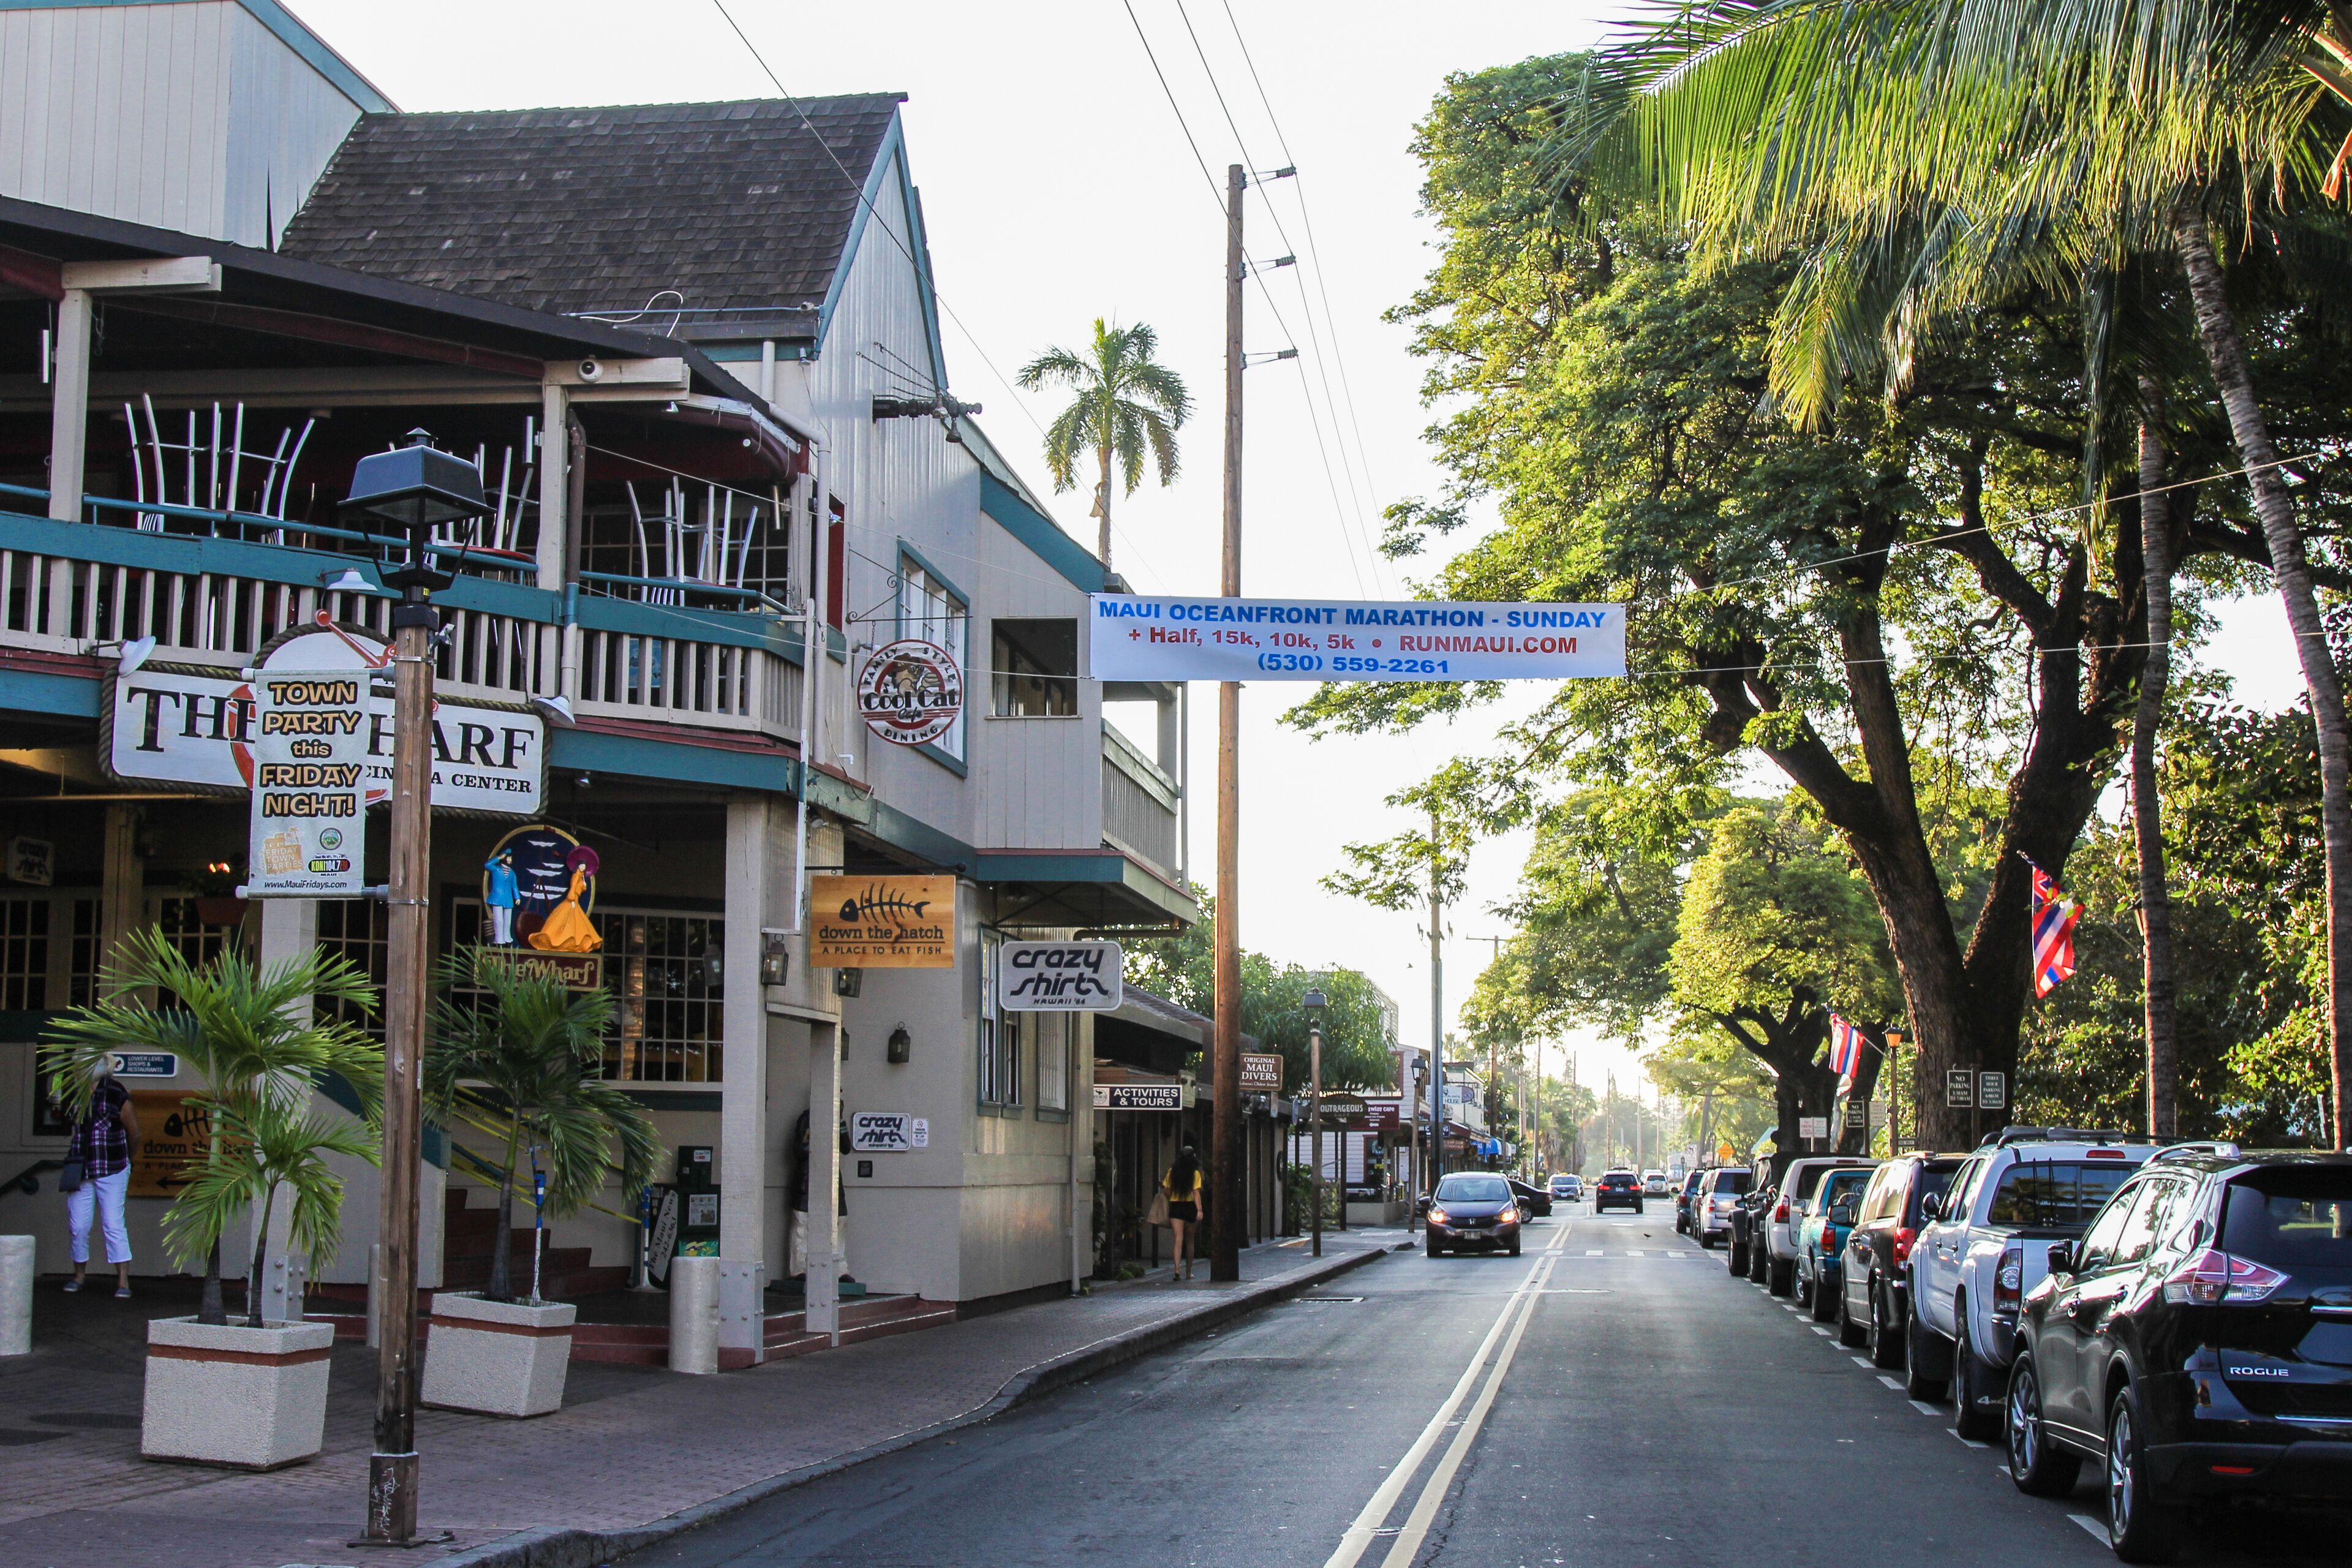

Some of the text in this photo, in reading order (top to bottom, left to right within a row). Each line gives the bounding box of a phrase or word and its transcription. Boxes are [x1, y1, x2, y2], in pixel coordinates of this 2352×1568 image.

[1099, 601, 1160, 619] MAUI
[1169, 604, 1337, 625] OCEANFRONT
[1345, 608, 1483, 627] MARATHON
[1507, 611, 1606, 628] SUNDAY
[1150, 627, 1202, 647] Half,
[1212, 630, 1261, 649] 15k,
[1269, 632, 1318, 651] 10k,
[1327, 634, 1355, 650] 5k
[1400, 635, 1577, 654] RUNMAUI.COM
[864, 647, 898, 685] FAMILY
[922, 647, 956, 682] STYLE
[1257, 652, 1449, 674] (530) 559-2261
[268, 682, 356, 704] TOWN
[864, 688, 958, 710] Cool Cat
[263, 711, 361, 733] PARTY
[883, 725, 938, 742] DINING
[292, 740, 331, 757] this
[261, 764, 361, 786] FRIDAY
[451, 773, 532, 793] CENTER
[264, 794, 355, 816] NIGHT!
[265, 846, 298, 856] FRIDAY
[266, 854, 295, 863] TOWN
[267, 859, 303, 870] PARTIES
[264, 880, 347, 890] www.MauiFridays.com
[819, 925, 944, 940] down the hatch
[822, 946, 941, 955] A PLACE TO EAT FISH
[1012, 949, 1104, 974] crazy
[526, 958, 595, 985] Wharf
[1009, 972, 1110, 996] shirts
[1242, 1071, 1278, 1081] DIVERS
[1246, 1063, 1273, 1072] MAUI
[1114, 1088, 1178, 1097] ACTIVITIES
[1119, 1097, 1174, 1106] & TOURS
[1320, 1104, 1363, 1113] OUTRAGEOUS
[859, 1116, 903, 1131] crazy
[858, 1129, 905, 1143] shirts
[143, 1140, 187, 1155] down
[649, 1191, 676, 1270] The Maui News
[2230, 1366, 2289, 1377] ROGUE
